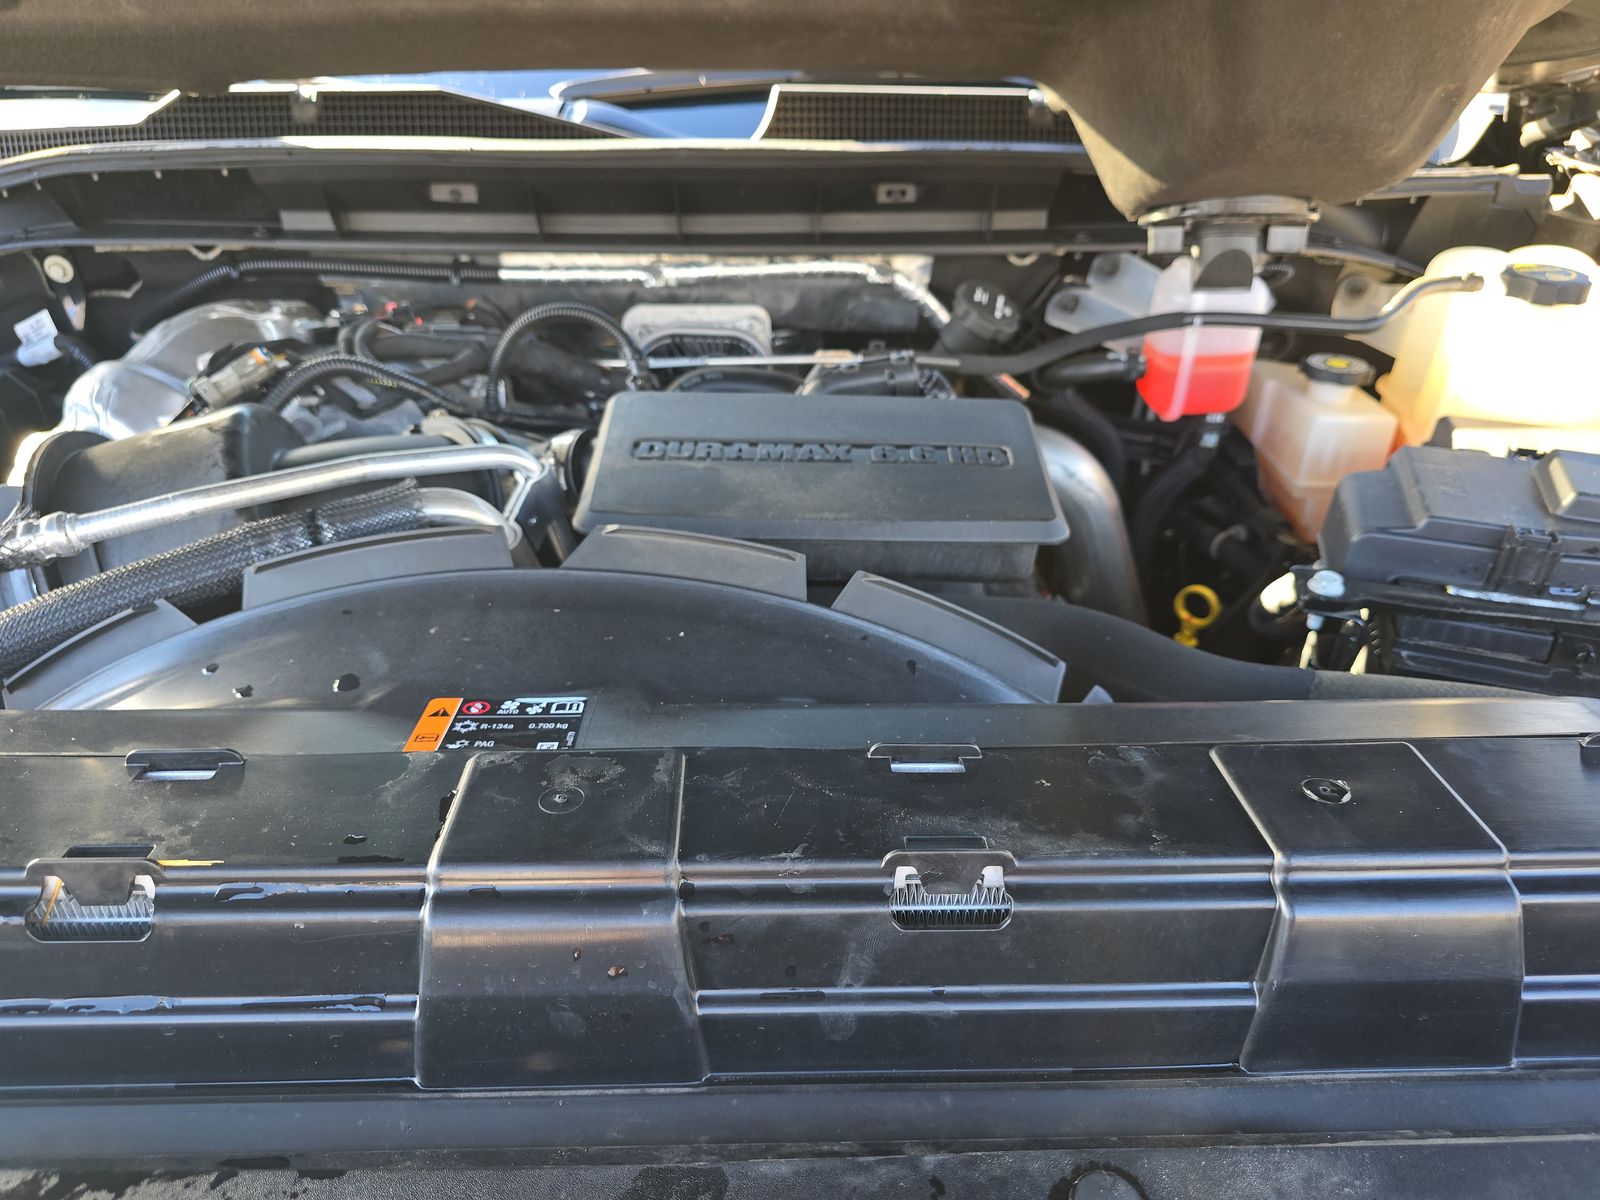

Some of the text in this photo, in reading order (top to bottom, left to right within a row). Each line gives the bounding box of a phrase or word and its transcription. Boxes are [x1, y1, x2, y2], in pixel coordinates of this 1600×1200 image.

[634, 440, 1007, 465] DURAMAX 6.6 HD
[480, 722, 514, 730] R-134a
[528, 722, 555, 730] 0.700
[473, 740, 496, 748] PAG
